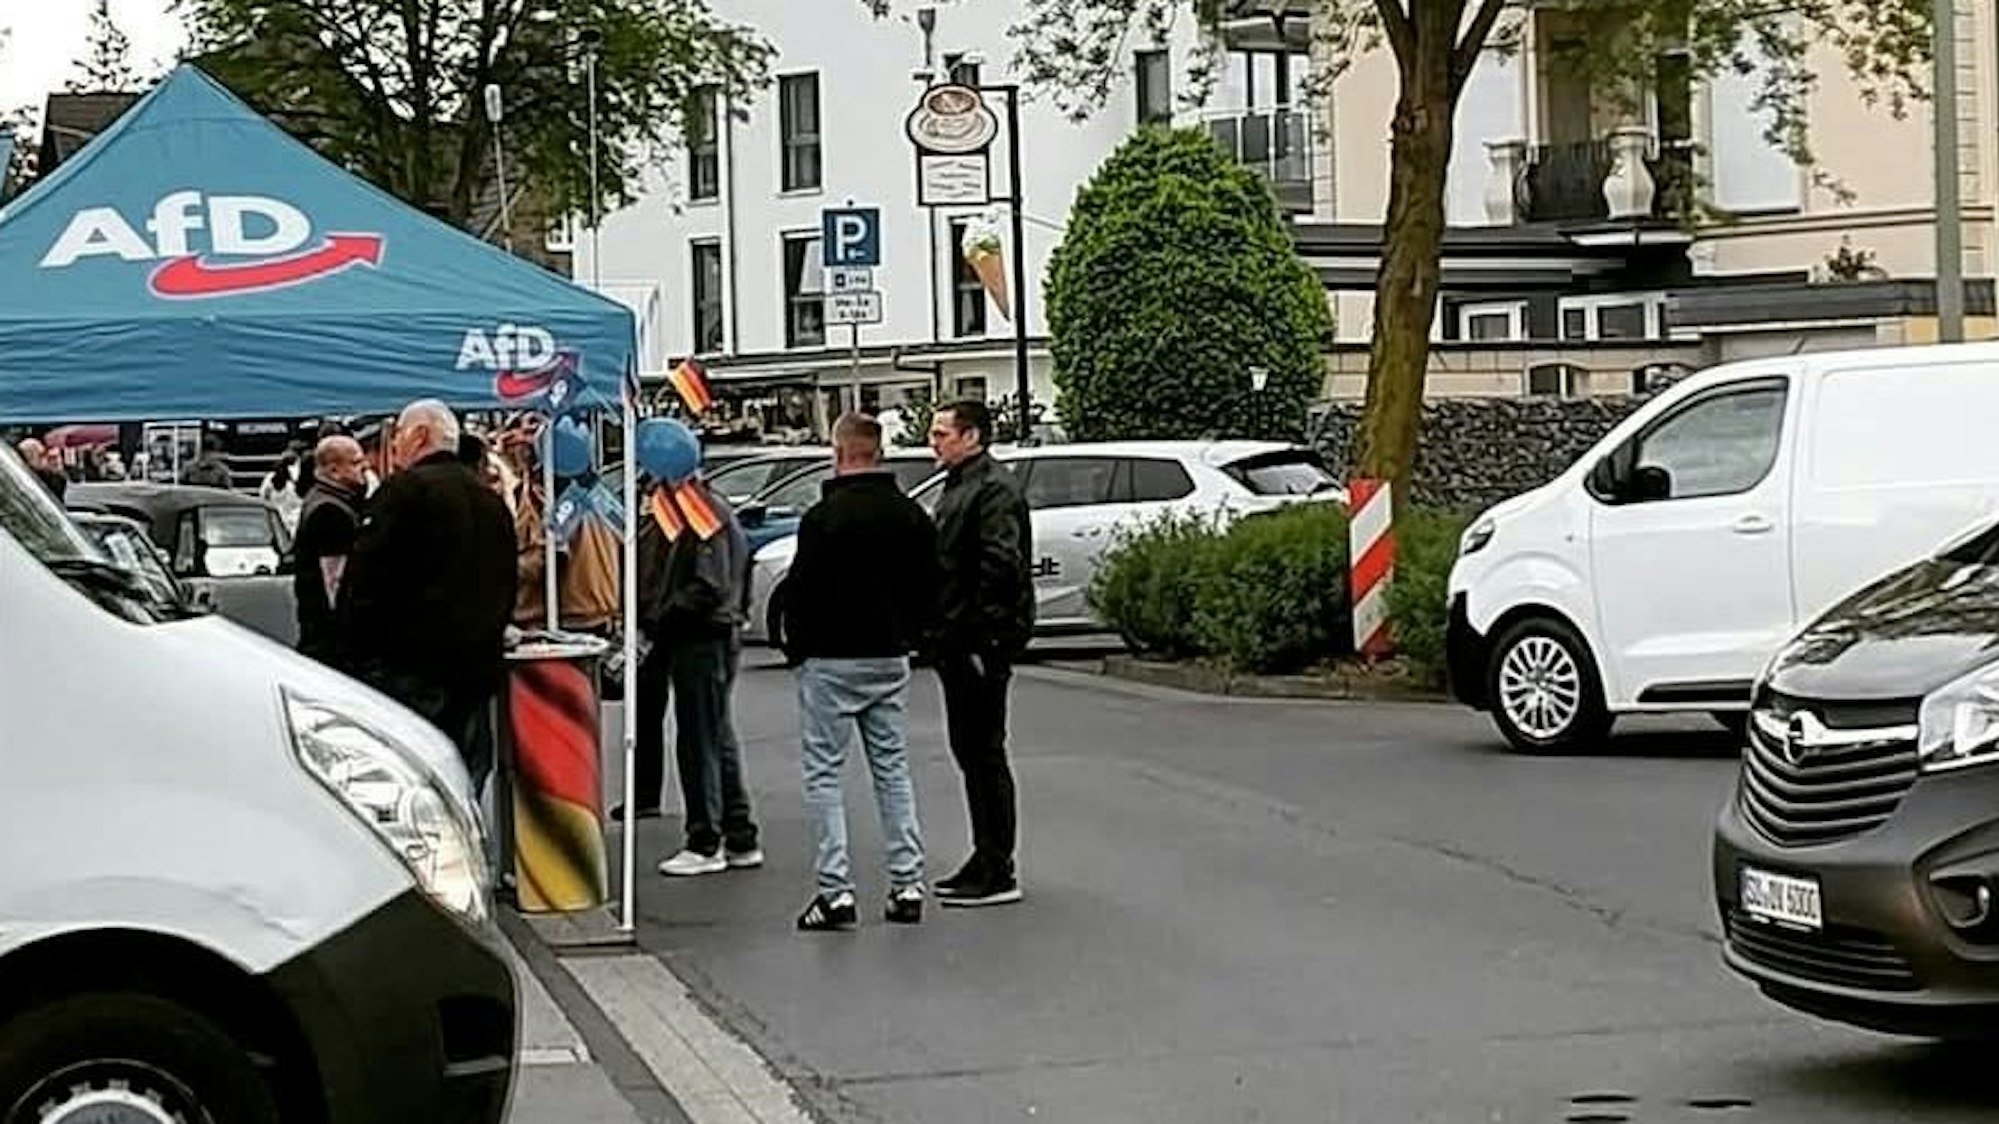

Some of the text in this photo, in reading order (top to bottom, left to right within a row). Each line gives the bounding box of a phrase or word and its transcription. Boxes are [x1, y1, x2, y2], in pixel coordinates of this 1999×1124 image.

[39, 191, 311, 267] AfD
[836, 215, 867, 260] P
[455, 324, 556, 370] AfD
[1030, 557, 1060, 577] dt
